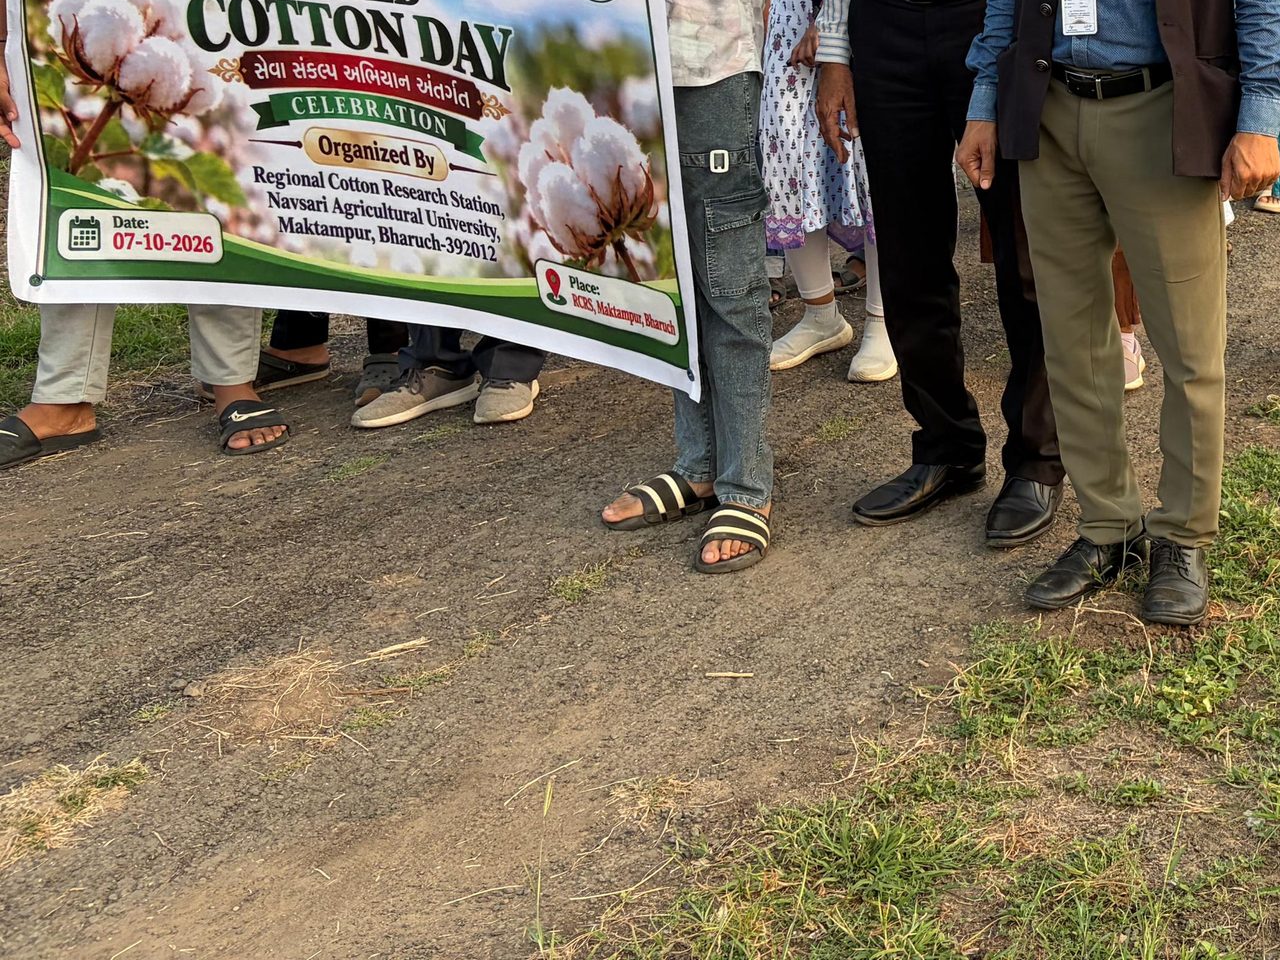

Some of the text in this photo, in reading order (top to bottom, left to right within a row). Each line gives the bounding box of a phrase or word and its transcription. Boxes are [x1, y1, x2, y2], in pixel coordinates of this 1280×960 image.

[413, 15, 513, 92] DAY
[254, 55, 470, 109] સેવા સંકલ્પ અભિયાન અંતર્ગત
[291, 96, 447, 137] CELEBRATION
[318, 134, 435, 175] Organized By
[253, 166, 505, 220] Regional Cotton Research Station,
[112, 215, 150, 229] Date:
[267, 191, 501, 243] Navsari Agricultural University,
[112, 231, 214, 254] 07-10-2026
[278, 216, 498, 263] Maktampur, Bharuch-392012
[568, 275, 600, 296] Place:
[571, 293, 676, 336] RCRS, Maktampur, Bharuch
